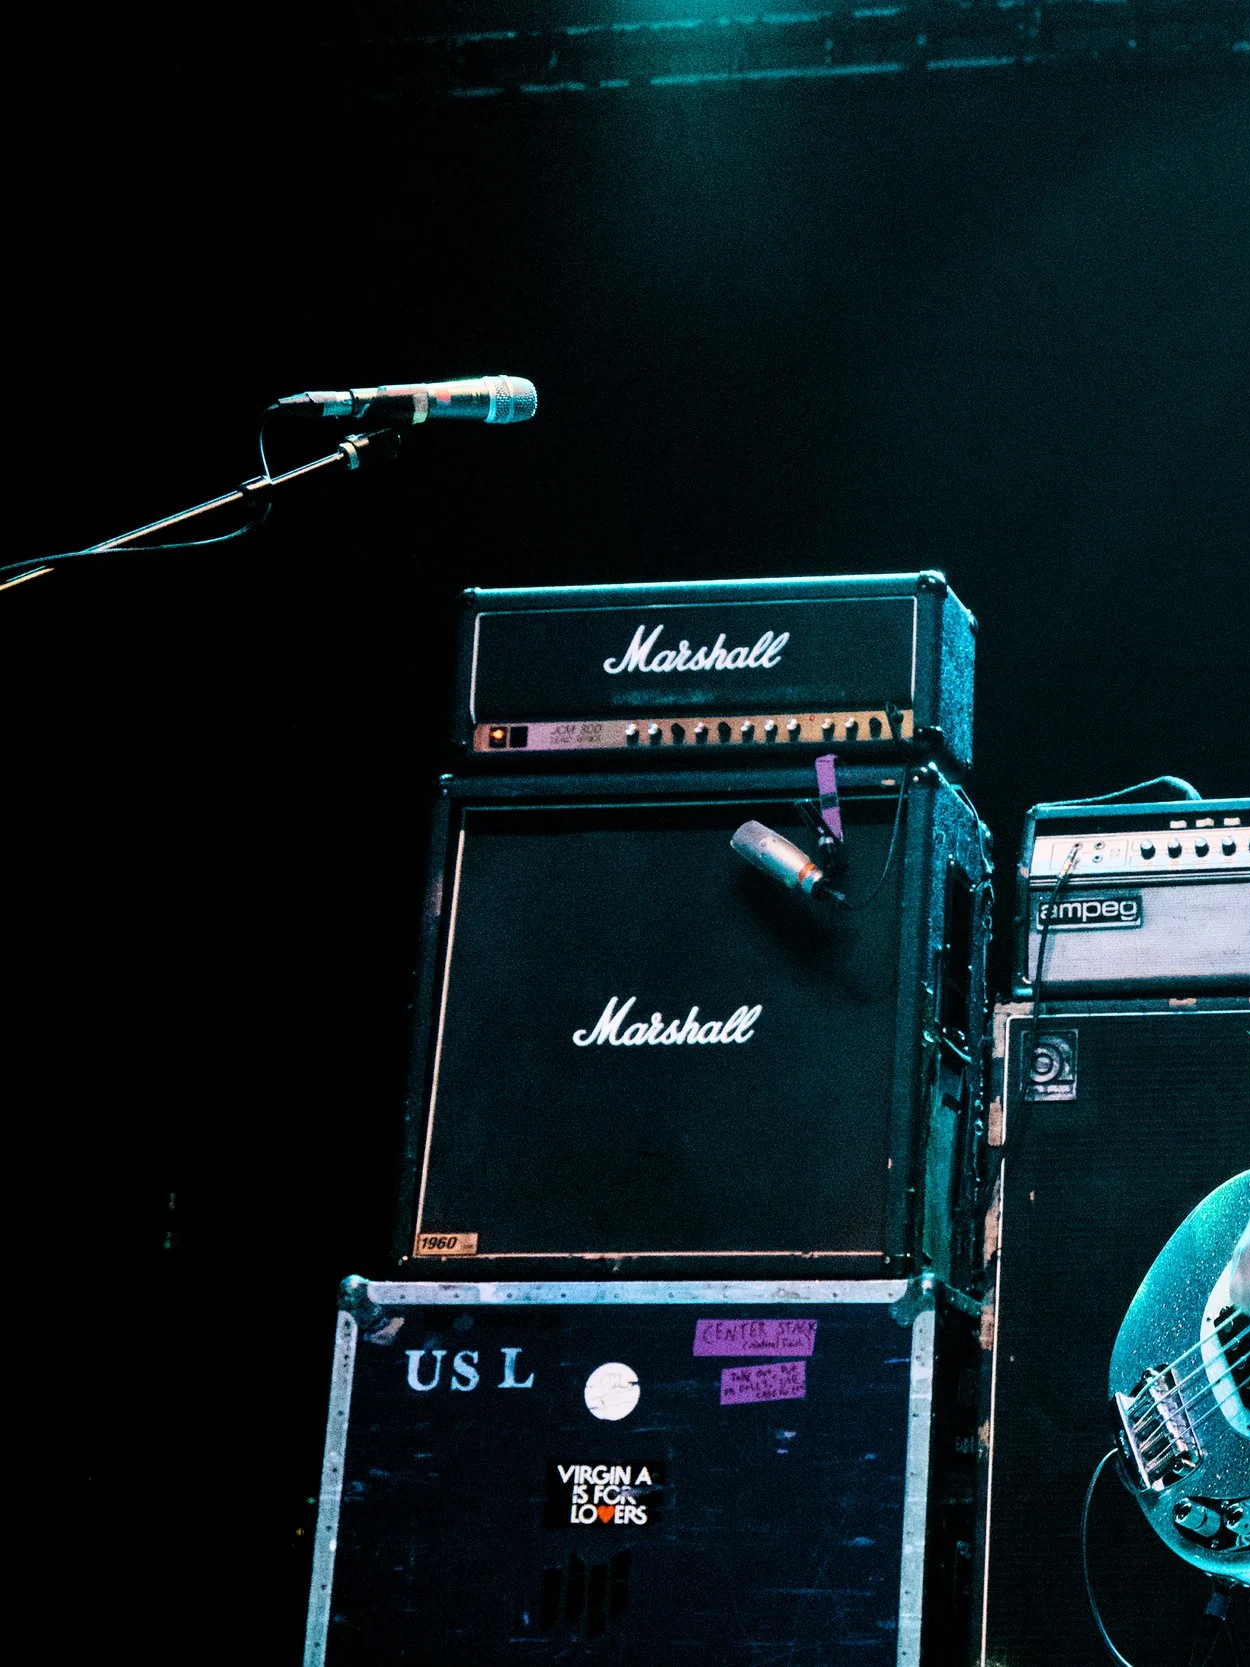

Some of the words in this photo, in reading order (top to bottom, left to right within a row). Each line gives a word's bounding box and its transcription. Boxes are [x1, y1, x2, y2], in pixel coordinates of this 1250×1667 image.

[603, 624, 790, 674] Marshall
[1040, 900, 1138, 923] ampeg
[573, 996, 763, 1046] Marshall
[421, 1236, 458, 1250] 1960
[703, 1321, 767, 1344] CENTER
[557, 1464, 652, 1486] VIRGINA
[572, 1484, 589, 1504] IS
[593, 1485, 637, 1505] FOR
